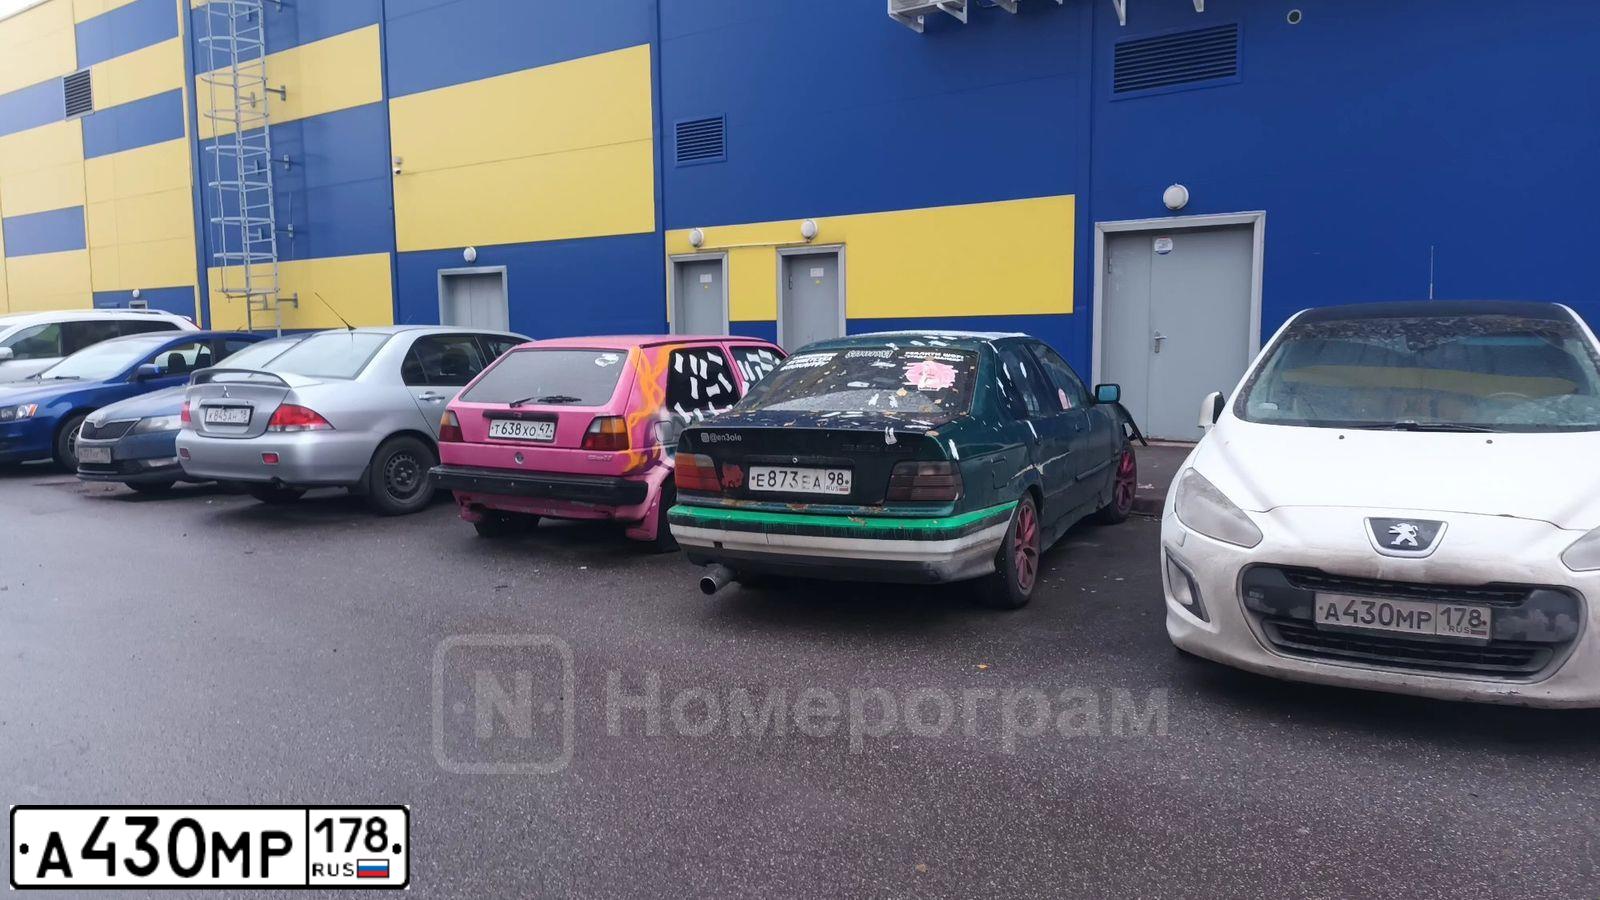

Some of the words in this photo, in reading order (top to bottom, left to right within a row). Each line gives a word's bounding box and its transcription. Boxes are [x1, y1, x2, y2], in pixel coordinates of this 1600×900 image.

[495, 421, 537, 437] Т638ХО
[539, 423, 551, 434] 47
[827, 471, 844, 486] 98
[1324, 600, 1432, 630] А430МР
[1440, 606, 1482, 628] 178
[1449, 625, 1470, 634] RUS
